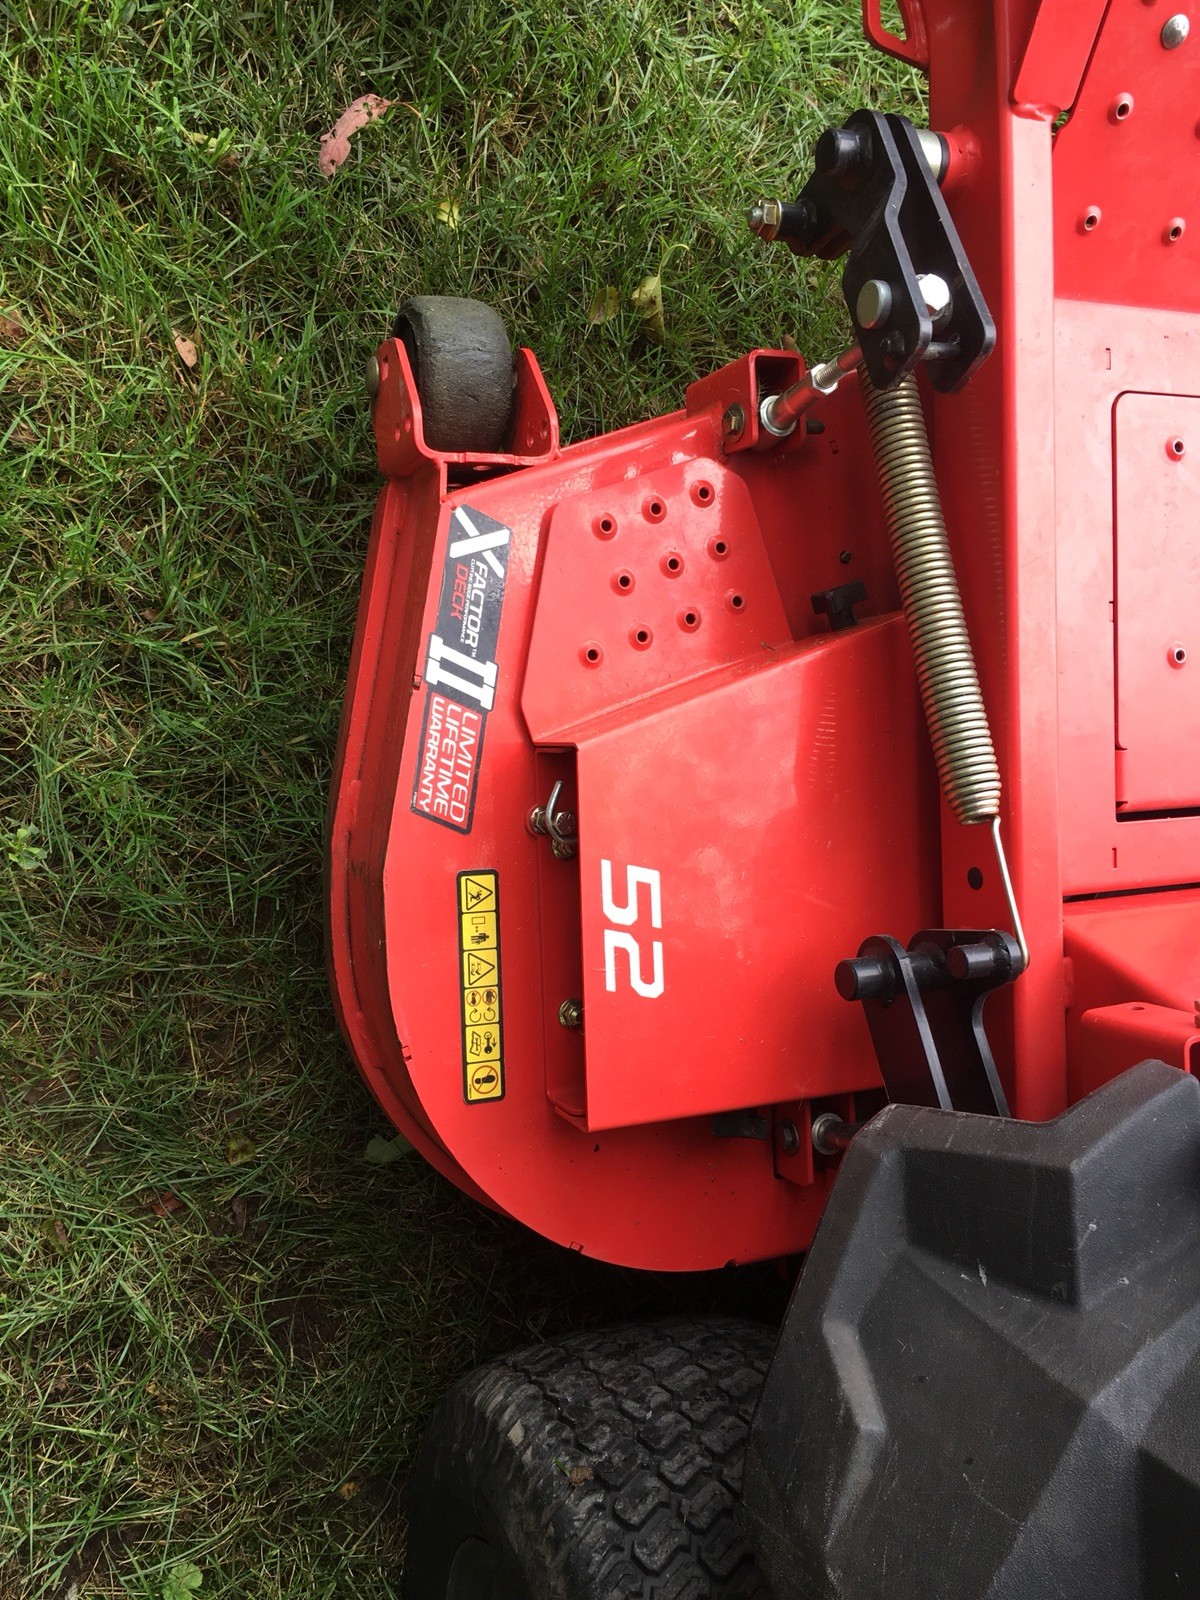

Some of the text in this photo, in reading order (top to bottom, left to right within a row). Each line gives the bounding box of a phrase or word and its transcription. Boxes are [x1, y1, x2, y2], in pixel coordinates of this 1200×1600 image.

[449, 506, 510, 578] X
[468, 558, 476, 583] CUTTING
[451, 563, 468, 620] DECK
[460, 599, 470, 643] PERFORMANCE
[419, 696, 445, 812] WARRANTY
[434, 704, 462, 816] LIFETIME
[450, 711, 479, 822] LIMITED
[601, 859, 664, 999] 52
